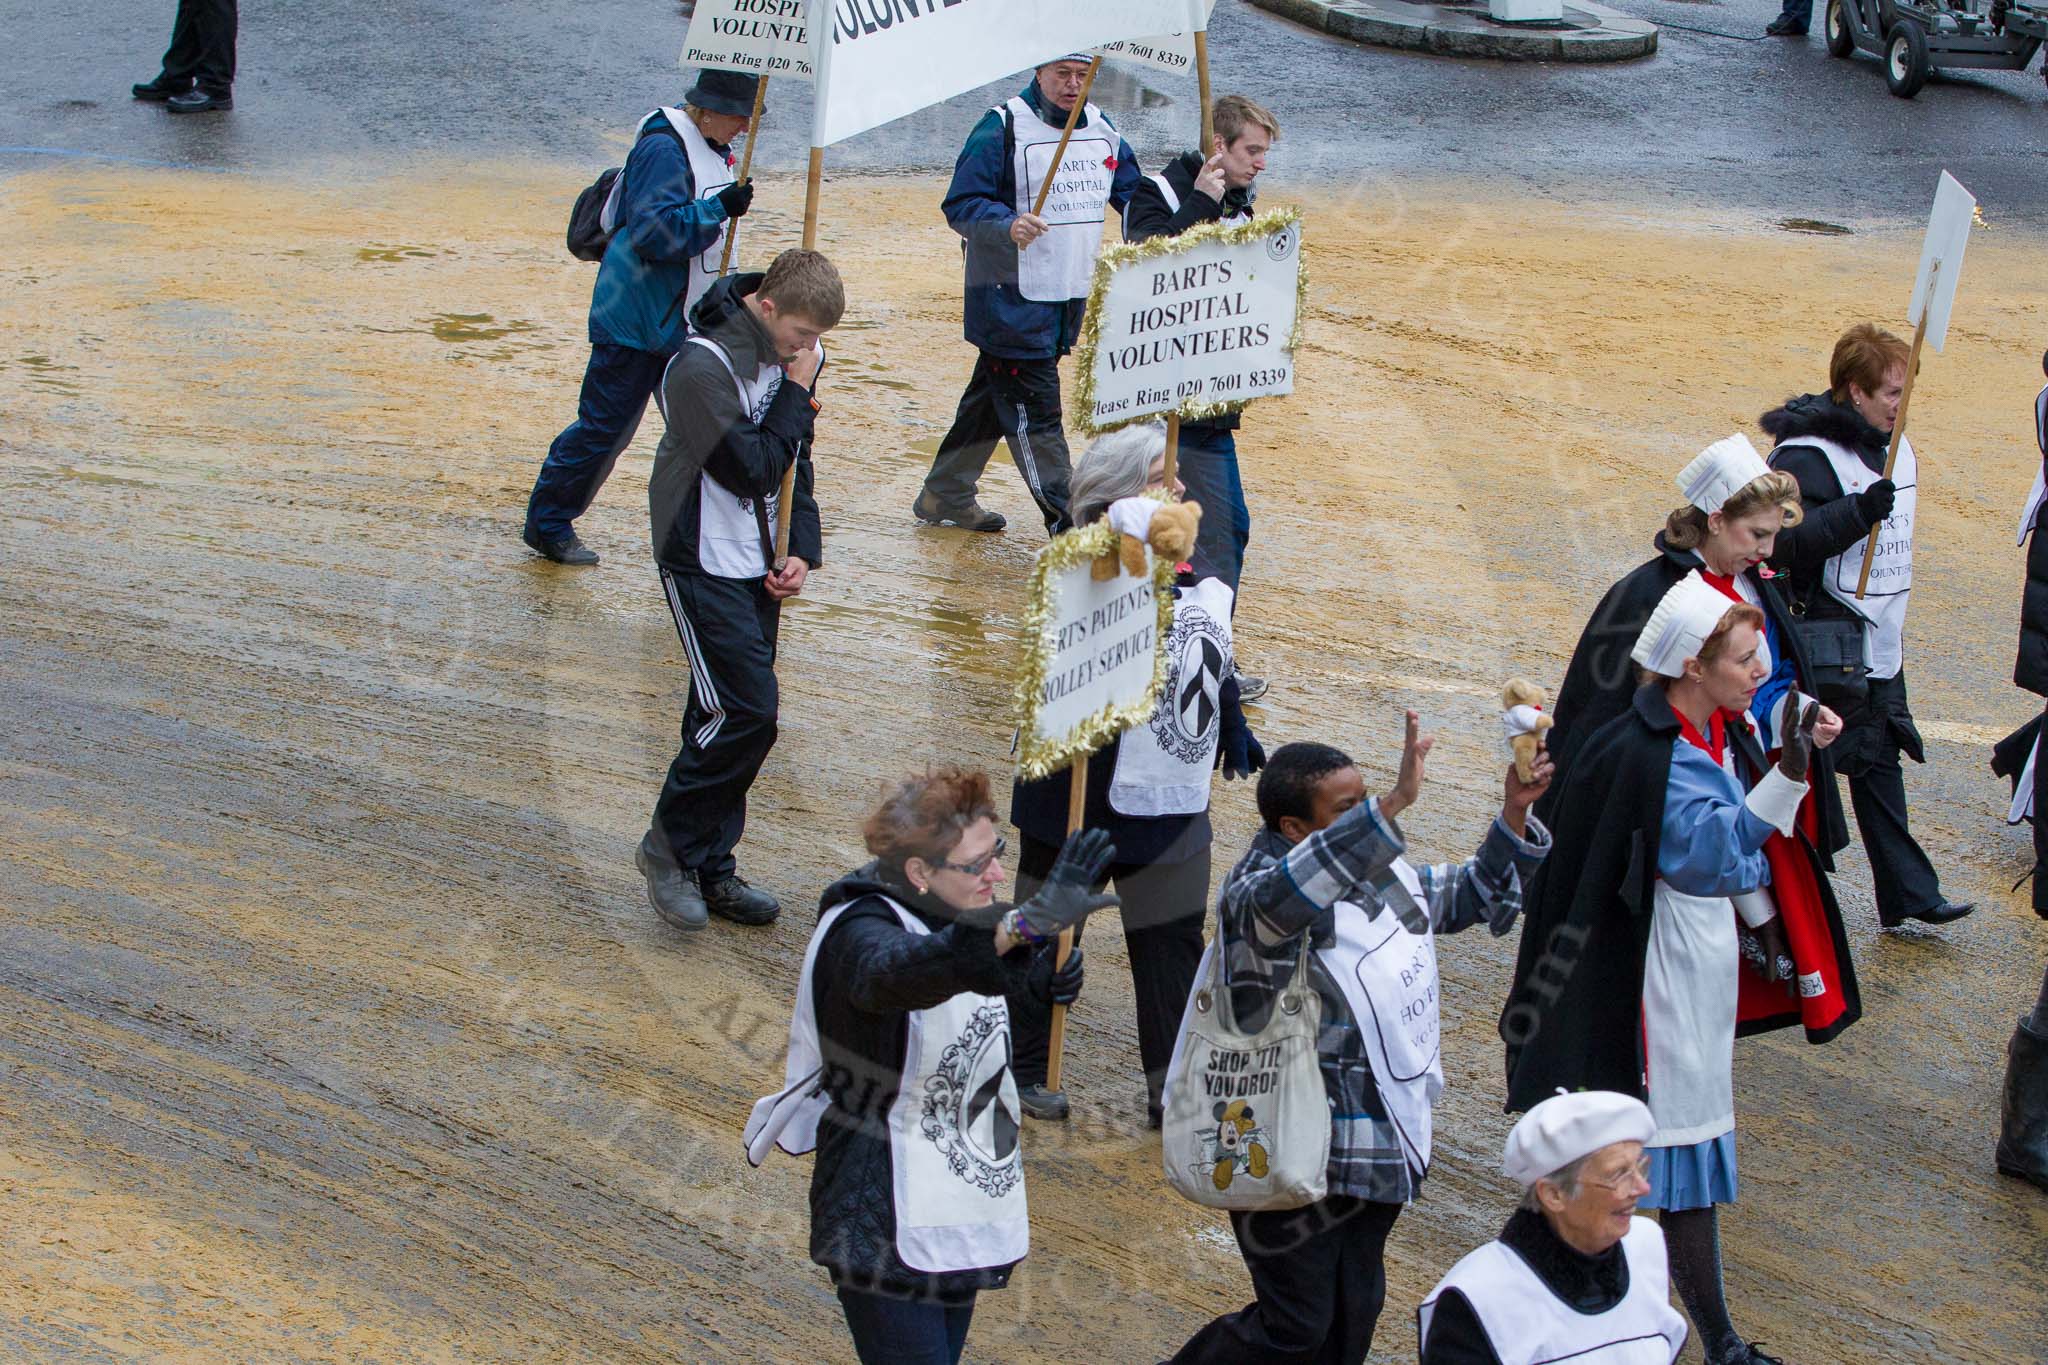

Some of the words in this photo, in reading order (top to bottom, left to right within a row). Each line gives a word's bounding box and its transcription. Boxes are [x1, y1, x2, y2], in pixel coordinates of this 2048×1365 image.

[734, 0, 804, 19] HOSPI
[713, 17, 808, 44] VOLUNTE
[687, 48, 726, 62] Please
[732, 52, 762, 69] Ring
[767, 56, 790, 70] 020
[796, 60, 812, 74] 76
[1128, 43, 1153, 59] 7601
[1157, 50, 1187, 67] 8339
[1056, 160, 1097, 173] ART'S
[1152, 259, 1232, 296] BART'S
[1129, 292, 1249, 335] HOSPITAL
[1109, 323, 1269, 373] VOLUNTEERS
[1136, 387, 1170, 407] Ring
[1177, 379, 1202, 398] 020
[1210, 374, 1241, 394] 7601
[1249, 368, 1286, 388] 8339
[1041, 656, 1095, 706] ROLLEY
[1098, 624, 1152, 676] SERVICE
[1208, 1049, 1250, 1073] SHOP
[1205, 1073, 1235, 1098] YOU
[1236, 1071, 1278, 1097] DROP
